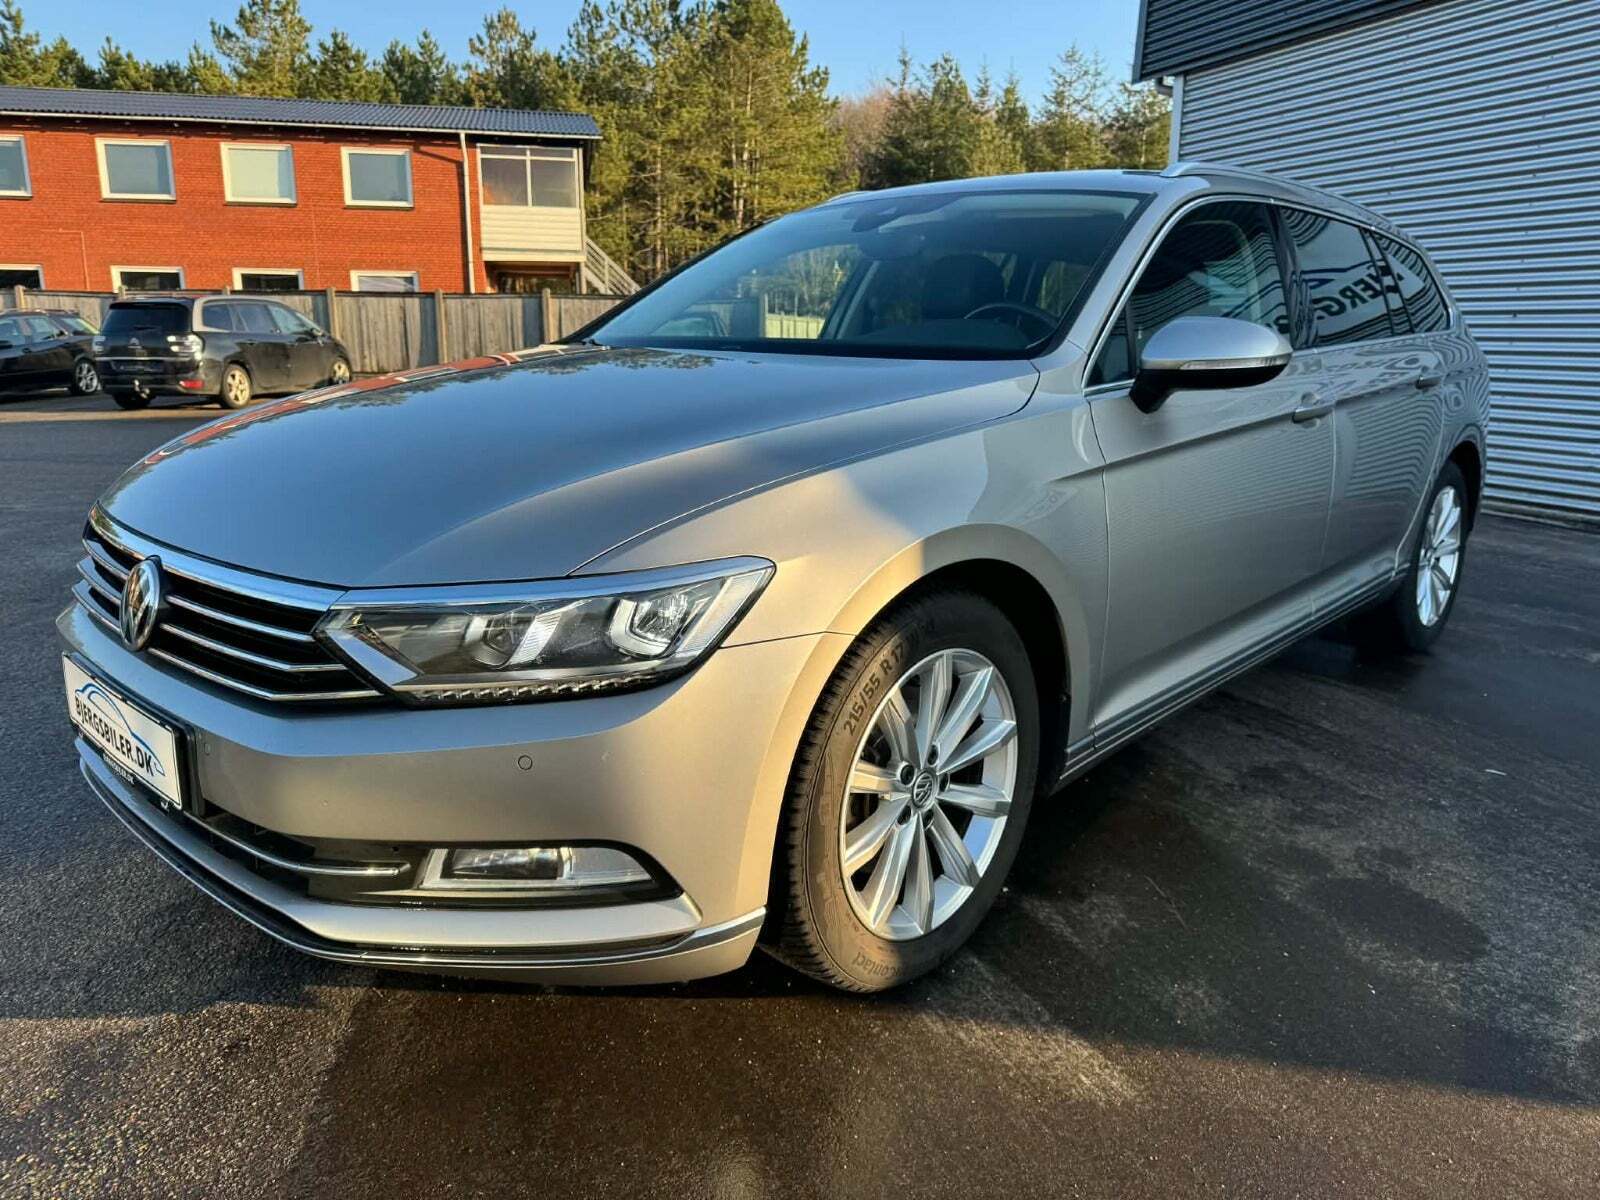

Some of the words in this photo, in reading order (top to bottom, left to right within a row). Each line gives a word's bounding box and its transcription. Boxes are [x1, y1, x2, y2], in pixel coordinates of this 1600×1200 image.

[74, 696, 154, 777] BJERGSBILER.DK
[843, 672, 881, 737] 215/55
[879, 659, 893, 676] R
